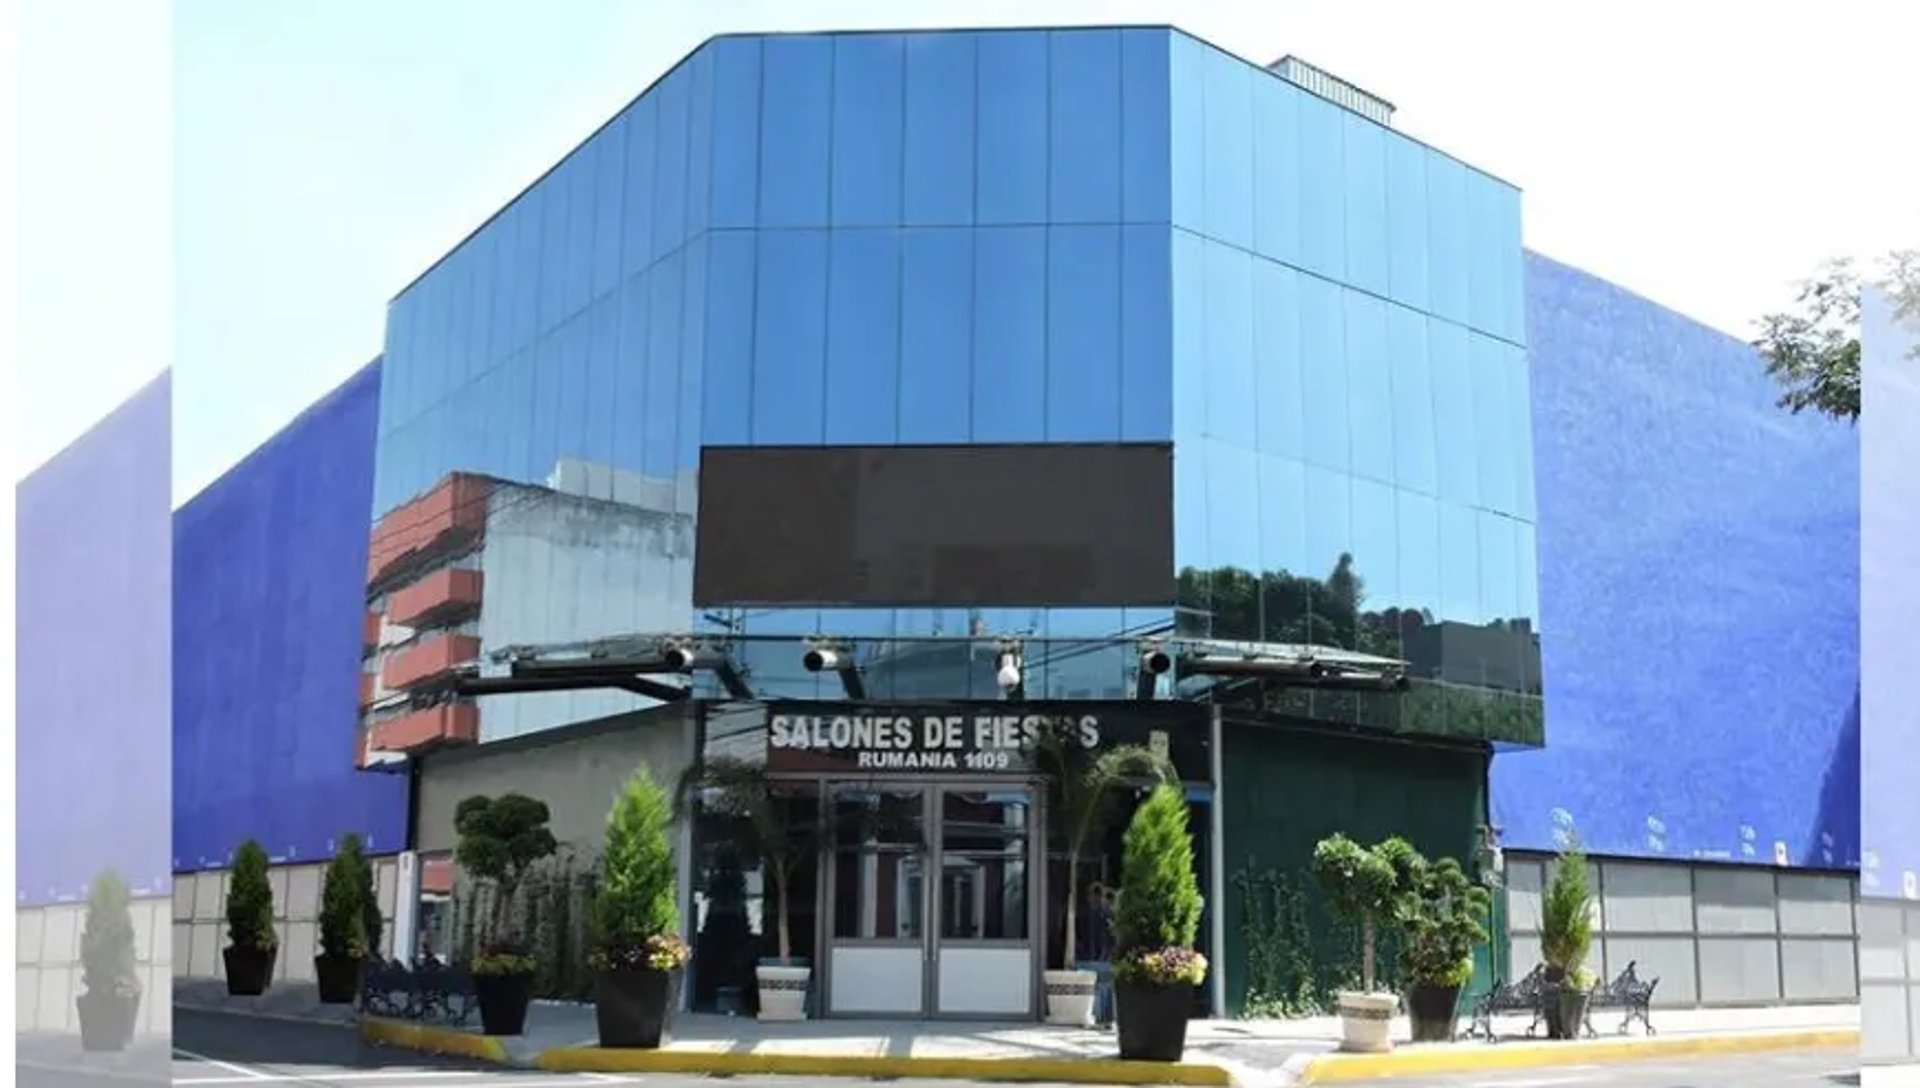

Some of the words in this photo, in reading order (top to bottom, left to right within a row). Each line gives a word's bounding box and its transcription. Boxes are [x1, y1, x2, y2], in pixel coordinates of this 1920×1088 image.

[771, 715, 912, 748] SALONES
[924, 716, 963, 748] DE
[974, 715, 1099, 748] FIESS
[858, 752, 957, 768] RUMANIA
[964, 752, 1009, 769] 1109
